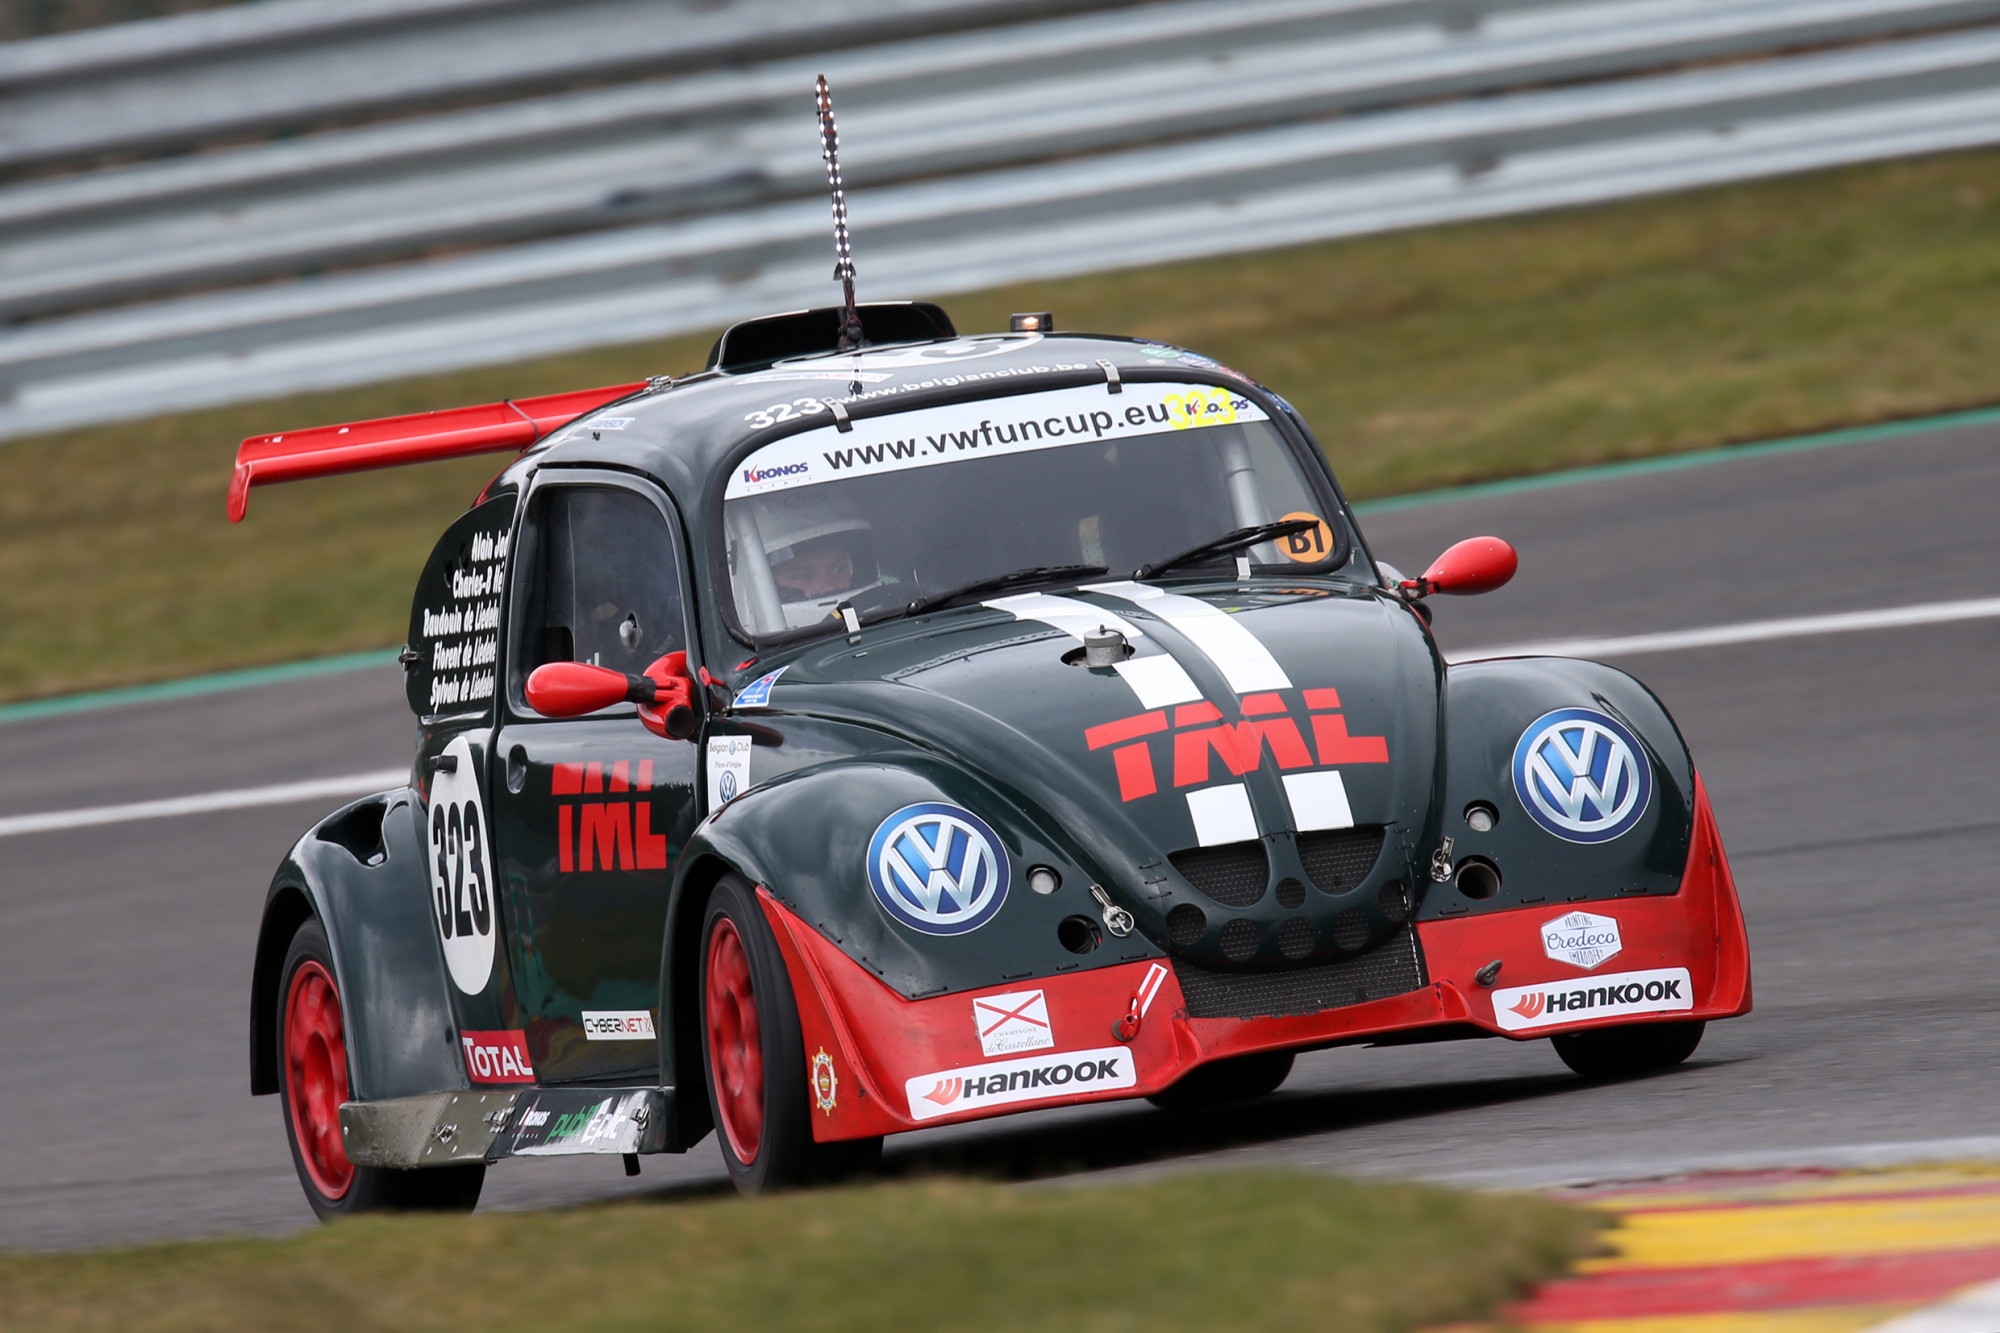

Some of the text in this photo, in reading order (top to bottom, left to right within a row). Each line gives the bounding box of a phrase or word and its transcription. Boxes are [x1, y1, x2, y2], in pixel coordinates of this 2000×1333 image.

[744, 397, 826, 429] 323
[1164, 387, 1237, 430] 323
[823, 402, 1171, 470] www.vwfuncup.eu
[743, 462, 809, 483] KRONOS
[471, 531, 493, 562] Alain
[423, 605, 462, 638] Baudouin
[463, 602, 474, 632] de
[433, 640, 462, 671] Florent
[462, 637, 473, 667] de
[430, 673, 460, 714] Sylvain
[460, 672, 470, 702] de
[709, 742, 750, 755] Belgian Club
[1084, 687, 1389, 803] TML
[552, 759, 668, 873] TML
[433, 800, 491, 940] 323
[1564, 914, 1593, 928] PRINTING
[1545, 930, 1618, 950] Credeco
[994, 1027, 1038, 1038] CHAMPAGNE
[994, 1035, 1050, 1052] Castellane
[462, 1037, 534, 1077] TOTAL
